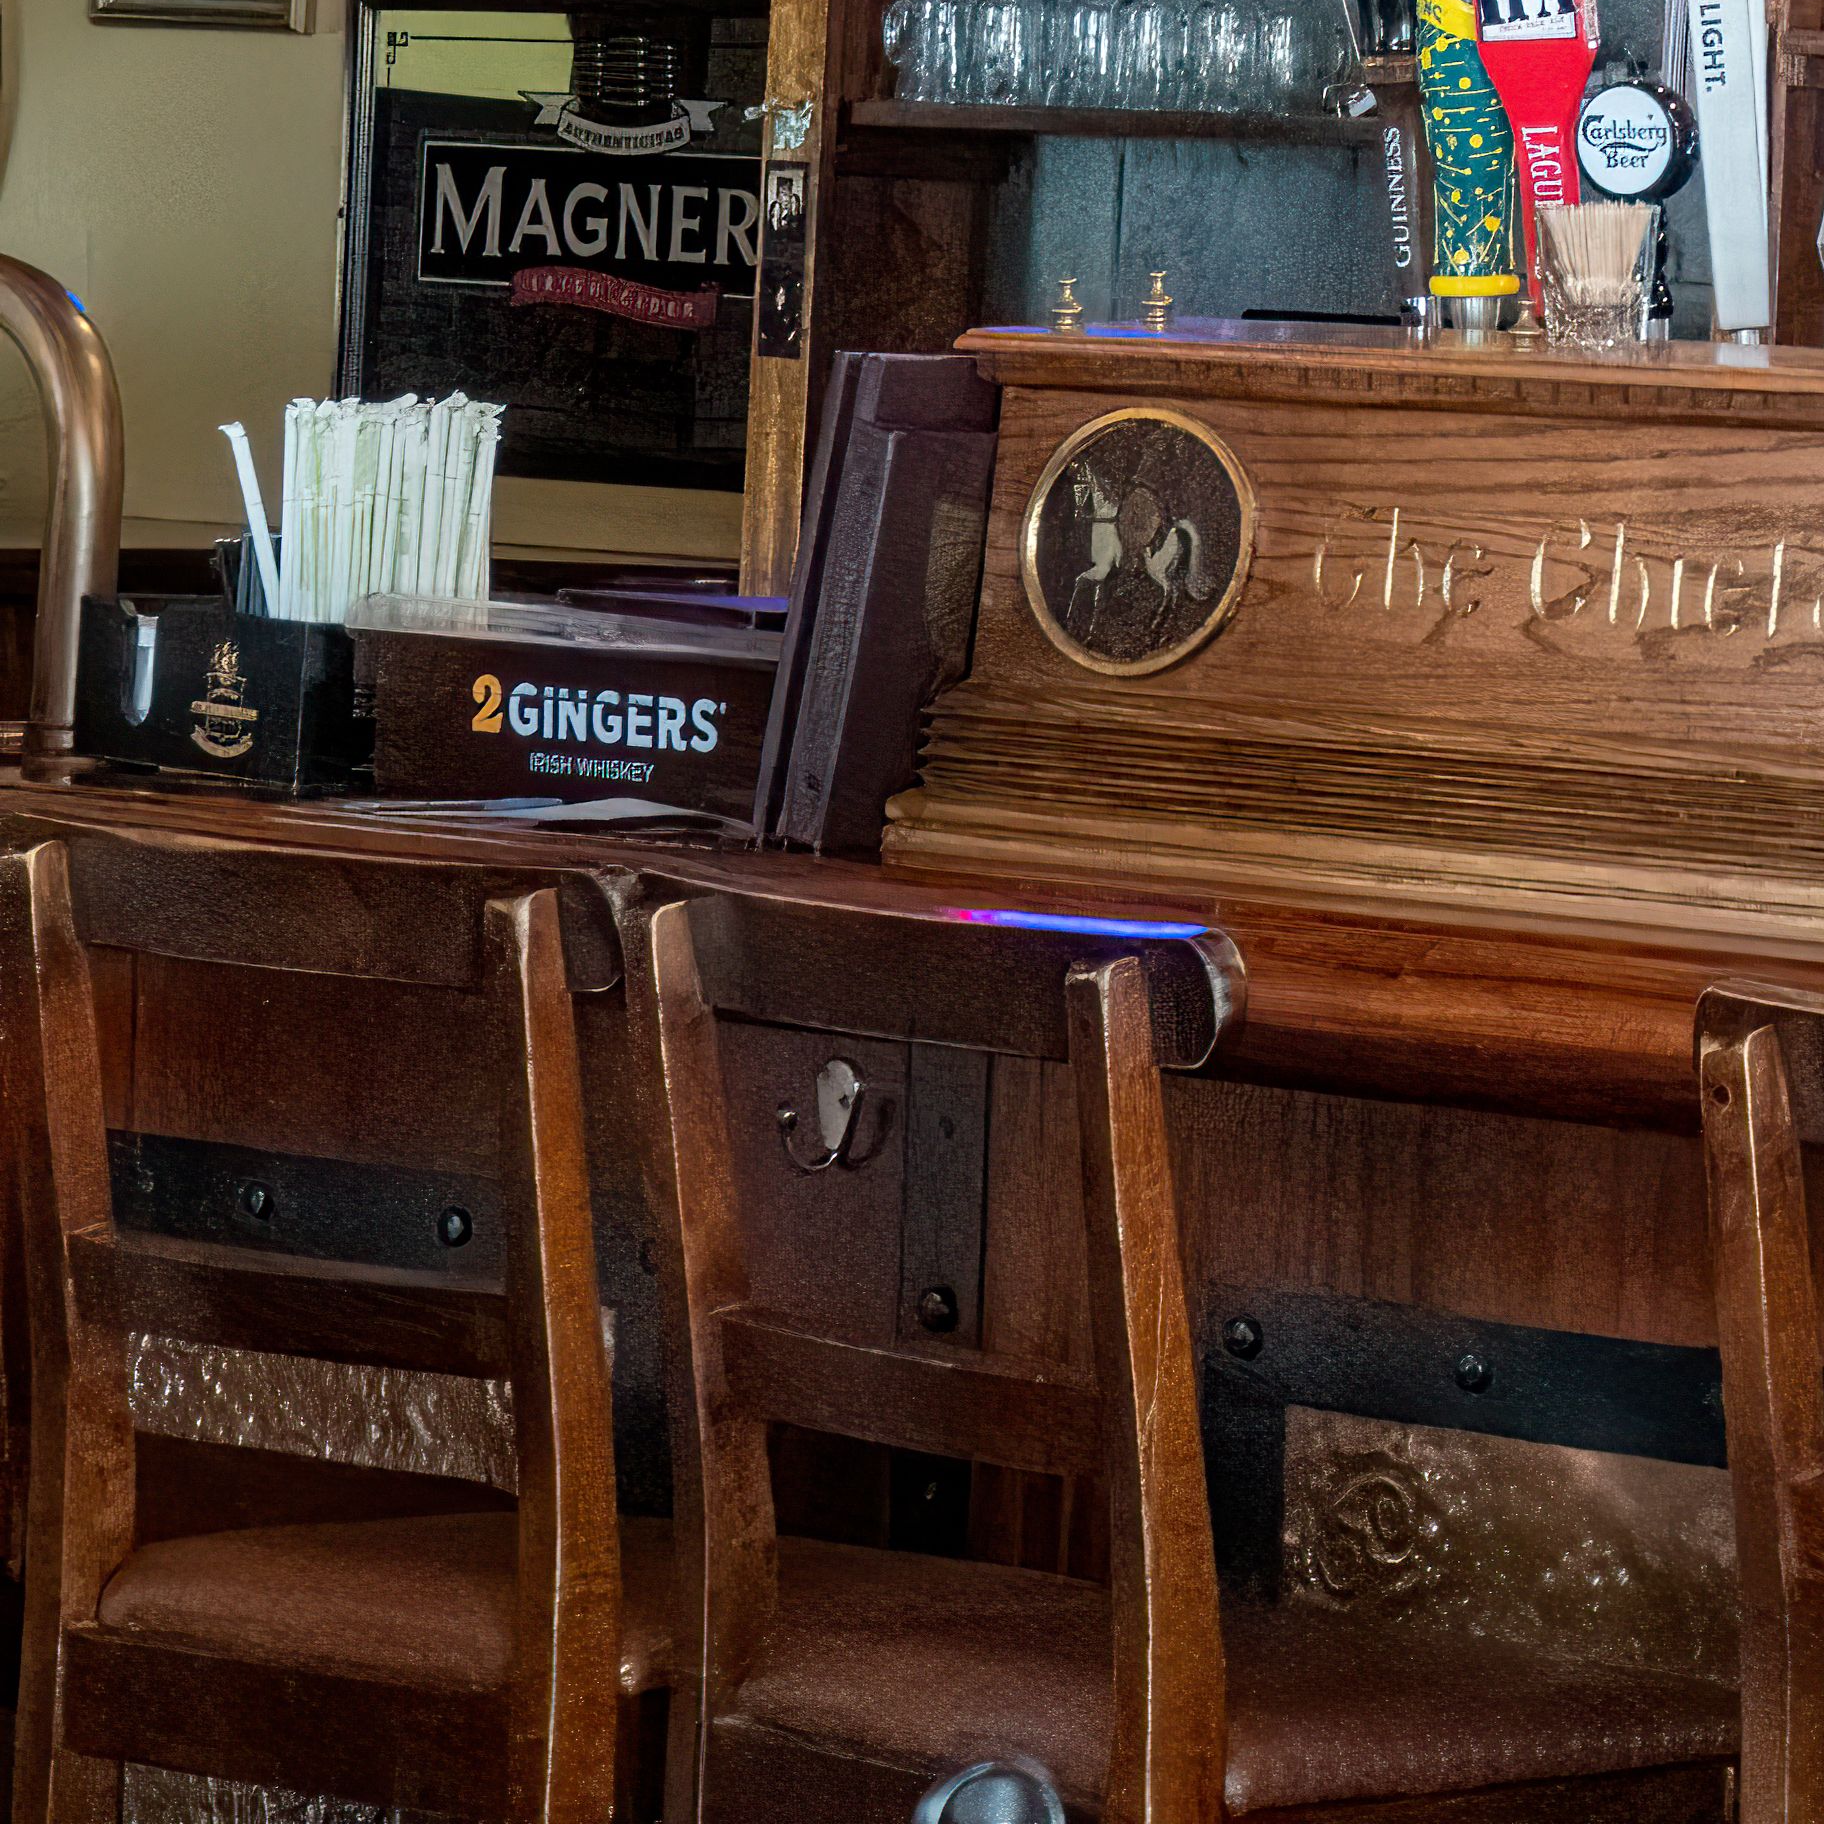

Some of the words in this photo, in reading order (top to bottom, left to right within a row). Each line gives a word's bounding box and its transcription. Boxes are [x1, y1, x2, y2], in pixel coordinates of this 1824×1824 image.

[1699, 3, 1727, 87] LIGHT
[1581, 114, 1667, 148] Carlsberg
[1605, 149, 1649, 169] Beer
[431, 162, 760, 267] MAGNER
[1382, 126, 1412, 269] GUINNESS
[529, 752, 573, 776] IRISH
[575, 755, 655, 784] WHISKEY
